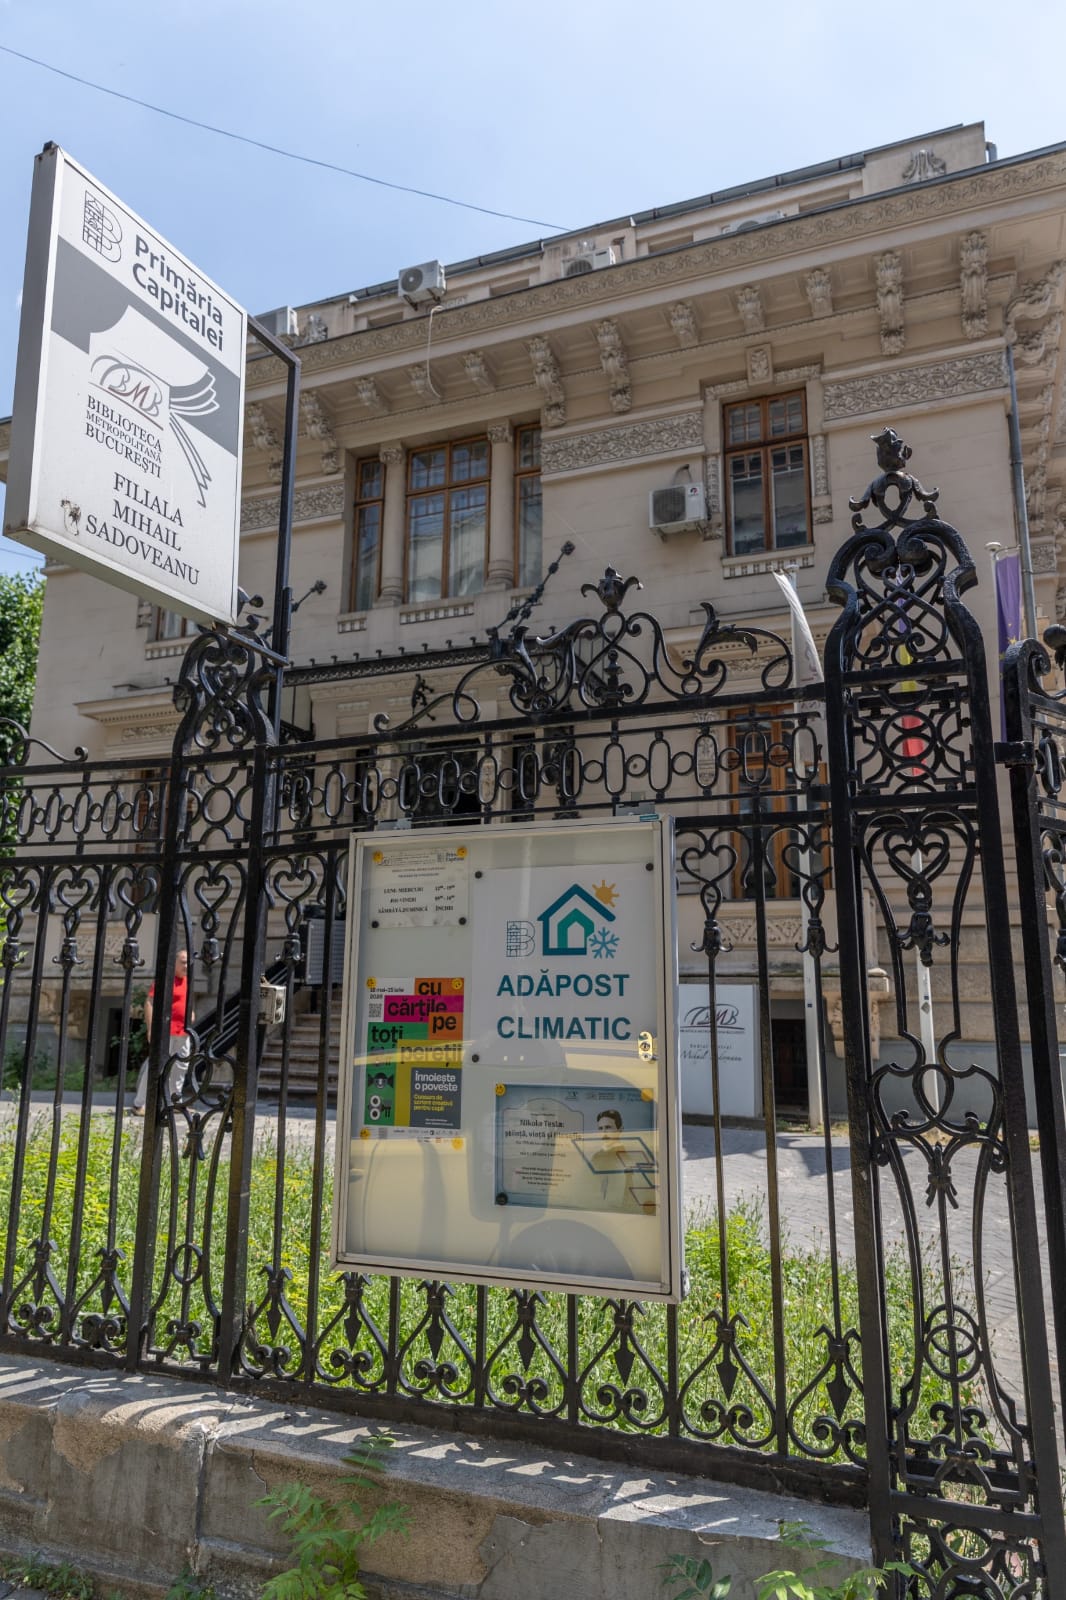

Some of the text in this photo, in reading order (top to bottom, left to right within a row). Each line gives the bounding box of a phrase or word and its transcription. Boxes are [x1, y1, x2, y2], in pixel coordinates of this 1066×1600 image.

[135, 234, 223, 326] Primăria
[132, 262, 223, 352] Capitalei
[86, 410, 162, 463] METROPOLITANĂ
[87, 394, 162, 451] BIBLIOTECA
[85, 422, 161, 479] BUCUREȘTI
[113, 471, 184, 528] FILIALA
[112, 499, 182, 552] MIHAIL
[86, 514, 200, 585] SADOVEANU
[418, 982, 442, 996] cu
[496, 968, 630, 997] ADĂPOST
[387, 998, 448, 1022] cărțile
[432, 1015, 457, 1034] pe
[496, 1015, 632, 1041] CLIMATIC
[371, 1025, 404, 1049] toți
[401, 1044, 462, 1068] pereții
[414, 1082, 458, 1092] o poveste
